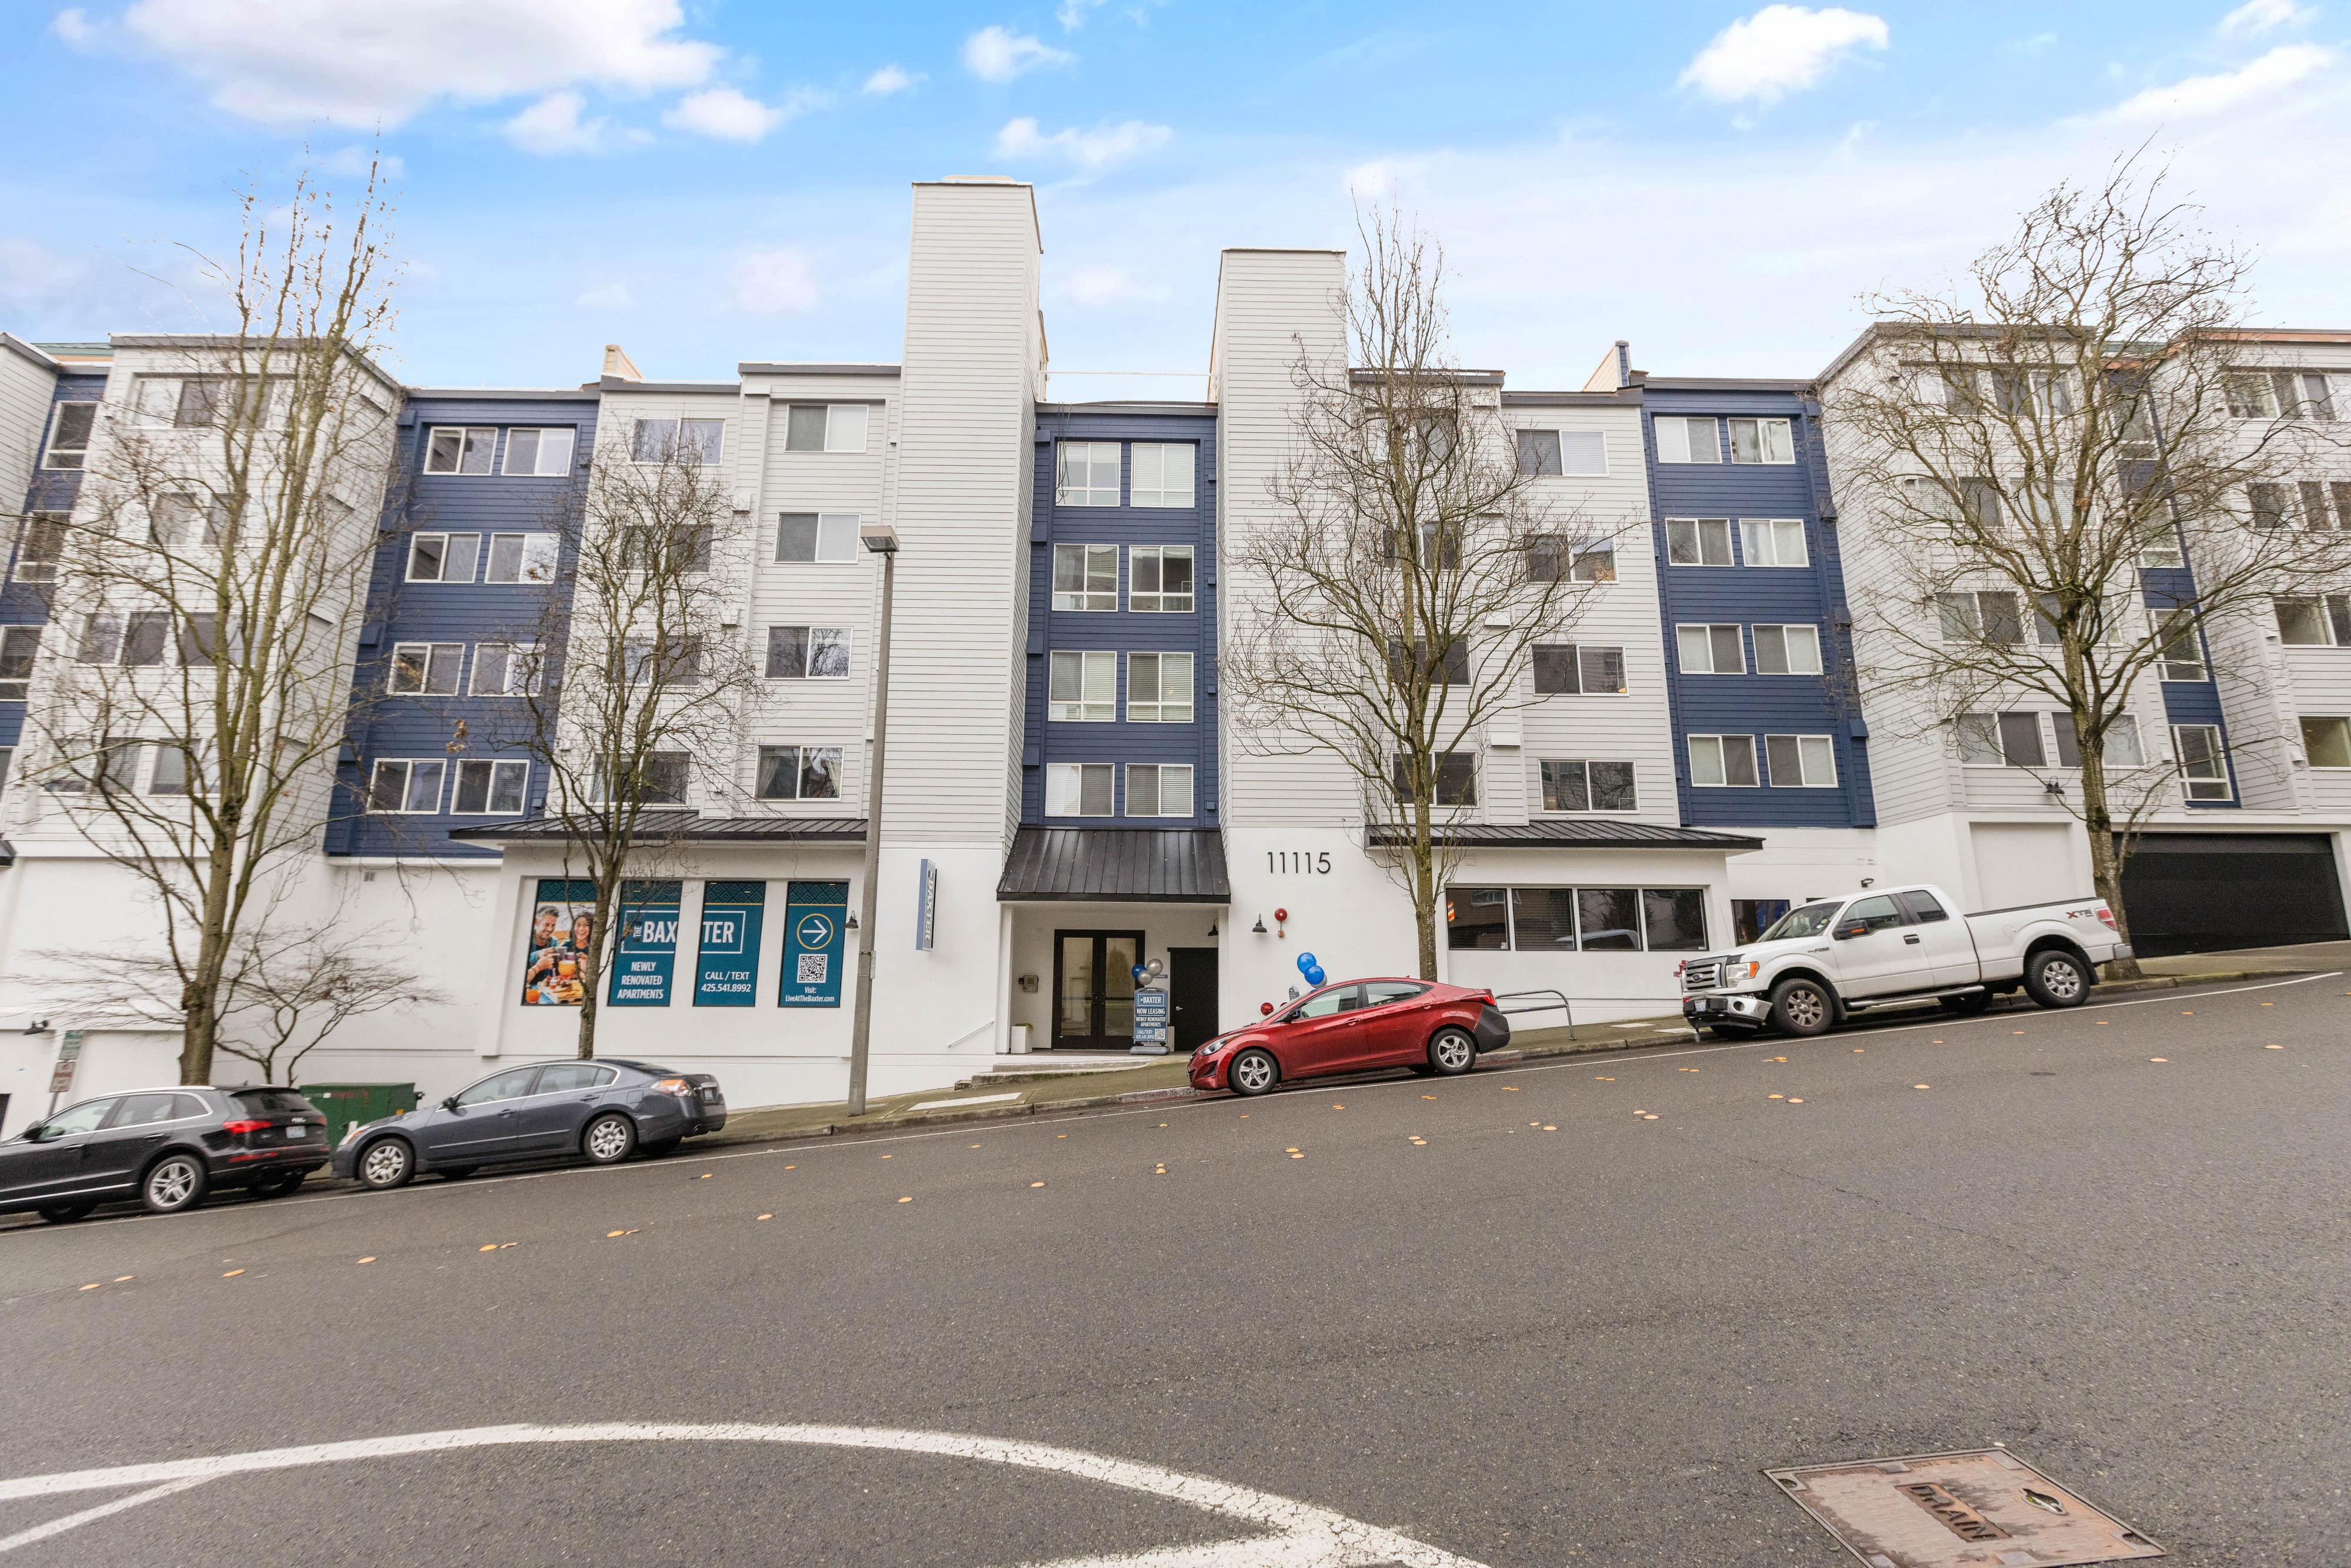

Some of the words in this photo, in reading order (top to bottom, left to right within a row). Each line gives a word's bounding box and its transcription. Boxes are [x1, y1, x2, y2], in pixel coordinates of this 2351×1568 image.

[1267, 852, 1331, 874] 11115
[925, 880, 933, 940] BAXTER
[633, 926, 642, 937] THE
[631, 961, 657, 971] NEWLY
[621, 975, 663, 985] RENOVATED
[705, 971, 724, 980] CALL
[731, 971, 750, 980] TEXT
[701, 984, 751, 992] 425.541.8992
[617, 989, 664, 999] APARTMENTS
[1910, 1485, 1997, 1539] DRAIN
